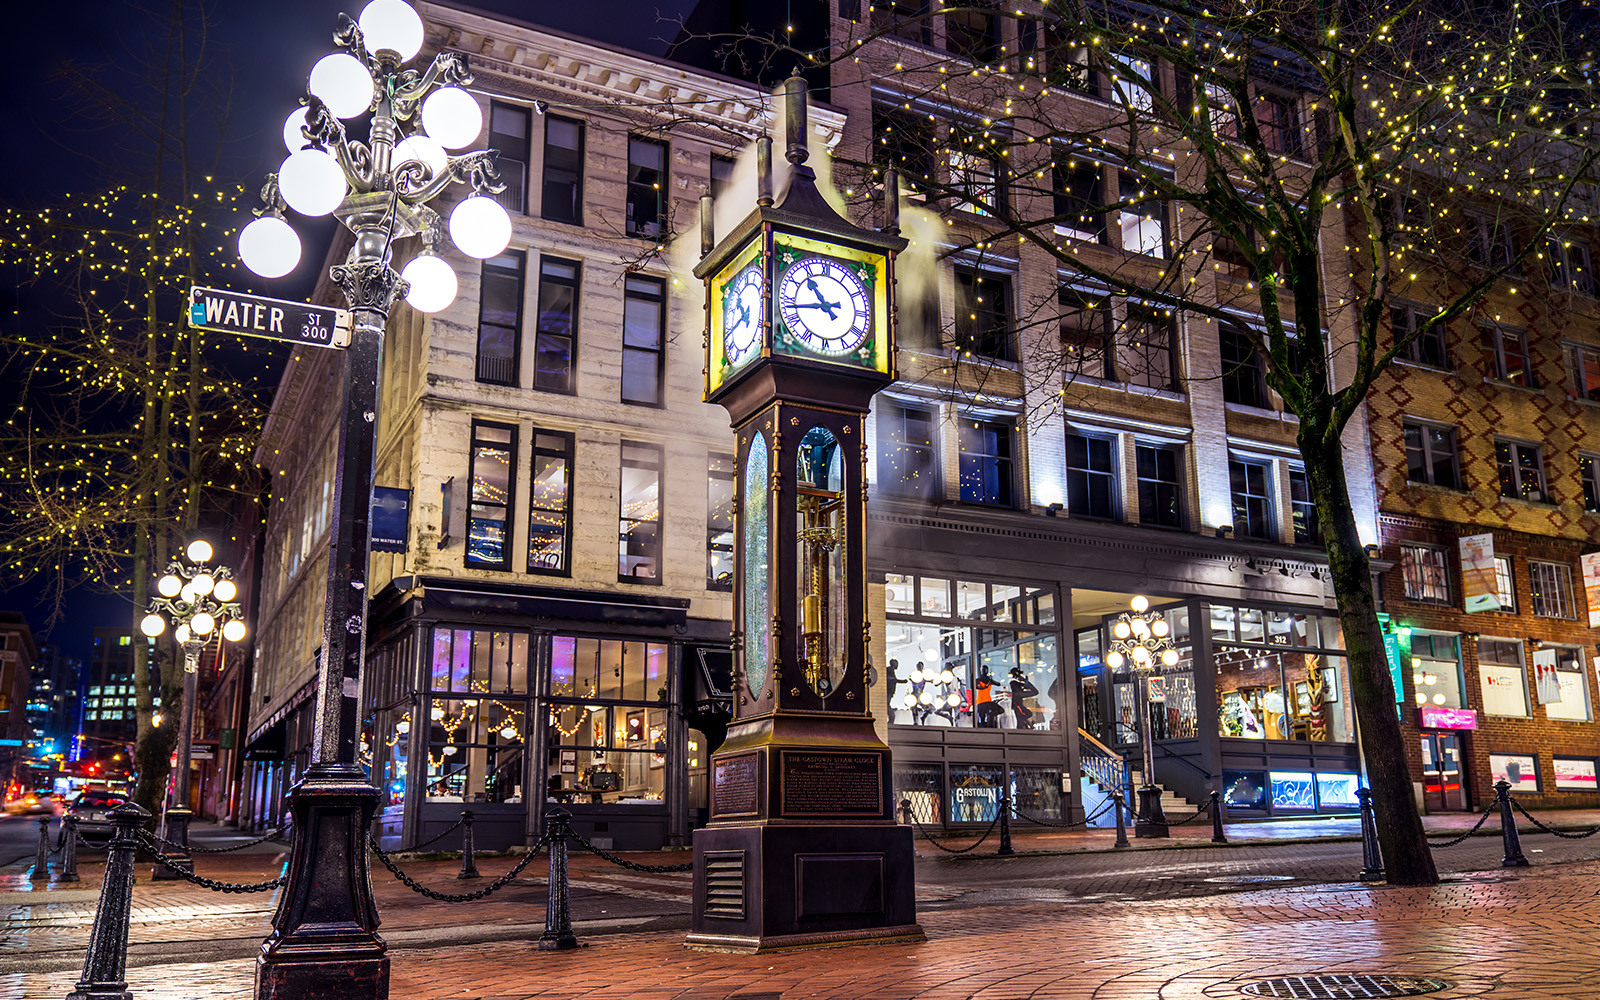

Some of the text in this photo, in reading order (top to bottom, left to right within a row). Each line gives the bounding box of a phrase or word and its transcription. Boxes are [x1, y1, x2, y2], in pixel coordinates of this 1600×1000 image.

[205, 296, 285, 334] WATER
[308, 313, 321, 326] ST
[302, 325, 328, 340] 300
[1274, 635, 1287, 644] 312
[956, 787, 997, 803] GASTOWN
